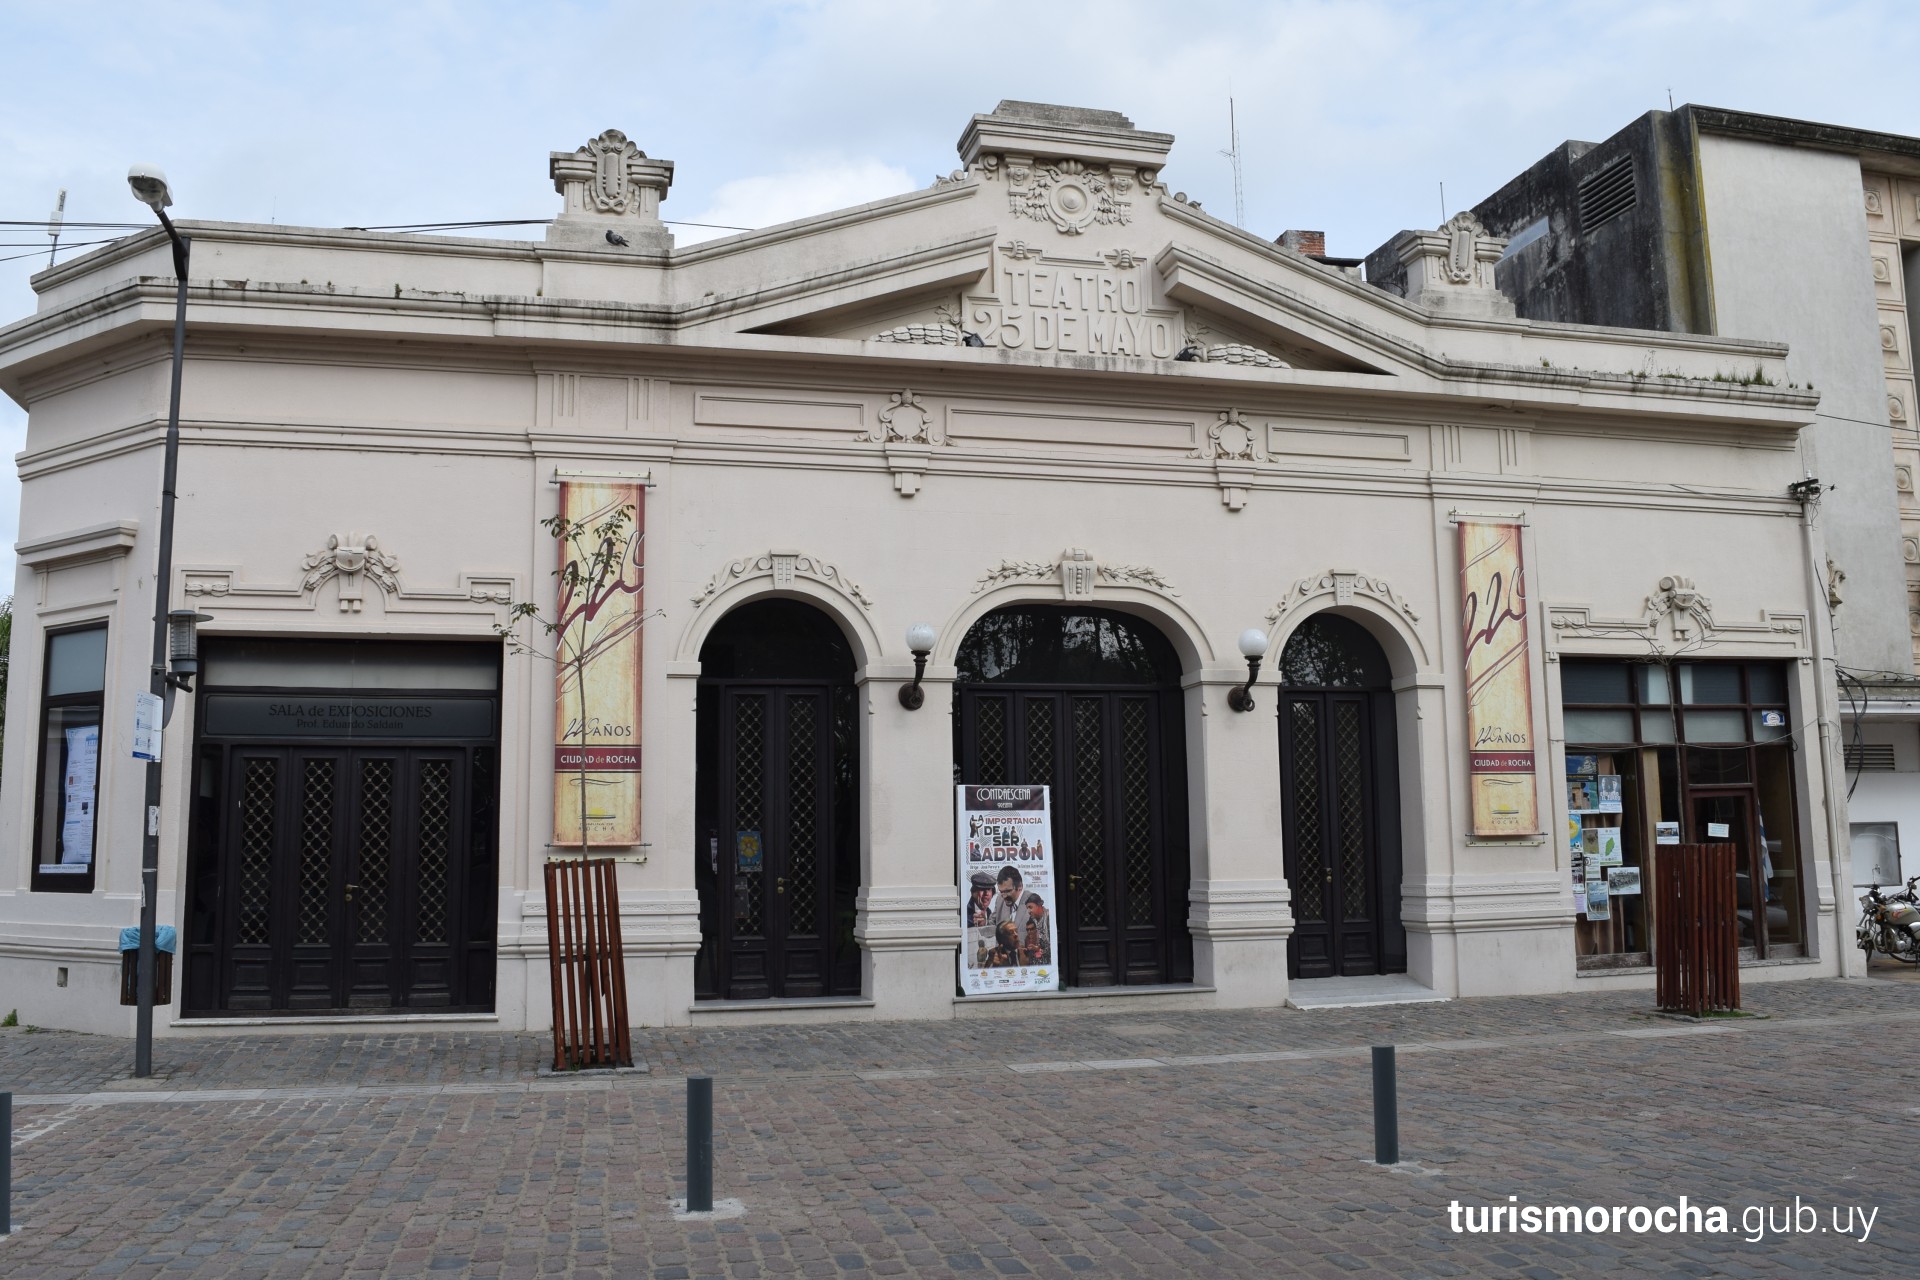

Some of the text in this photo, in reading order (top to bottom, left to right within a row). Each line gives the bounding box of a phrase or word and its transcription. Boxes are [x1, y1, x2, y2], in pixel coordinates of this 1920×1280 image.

[1003, 266, 1141, 314] TEATRO
[973, 307, 1171, 358] 25 DE MAYO
[269, 703, 432, 718] SALA de EXPOSICIONES
[296, 718, 318, 729] Prof.
[322, 719, 365, 730] Eduardo
[592, 724, 632, 737] AÑOS
[1496, 733, 1527, 744] AÑOS
[560, 755, 637, 764] CIUDAD de ROCHA
[1474, 759, 1532, 767] CIUDAD de ROCHA
[976, 787, 1031, 802] CONTRAESCENA
[985, 817, 1043, 825] IMPORTANCIA
[984, 826, 1001, 836] DE
[992, 836, 1020, 847] SER
